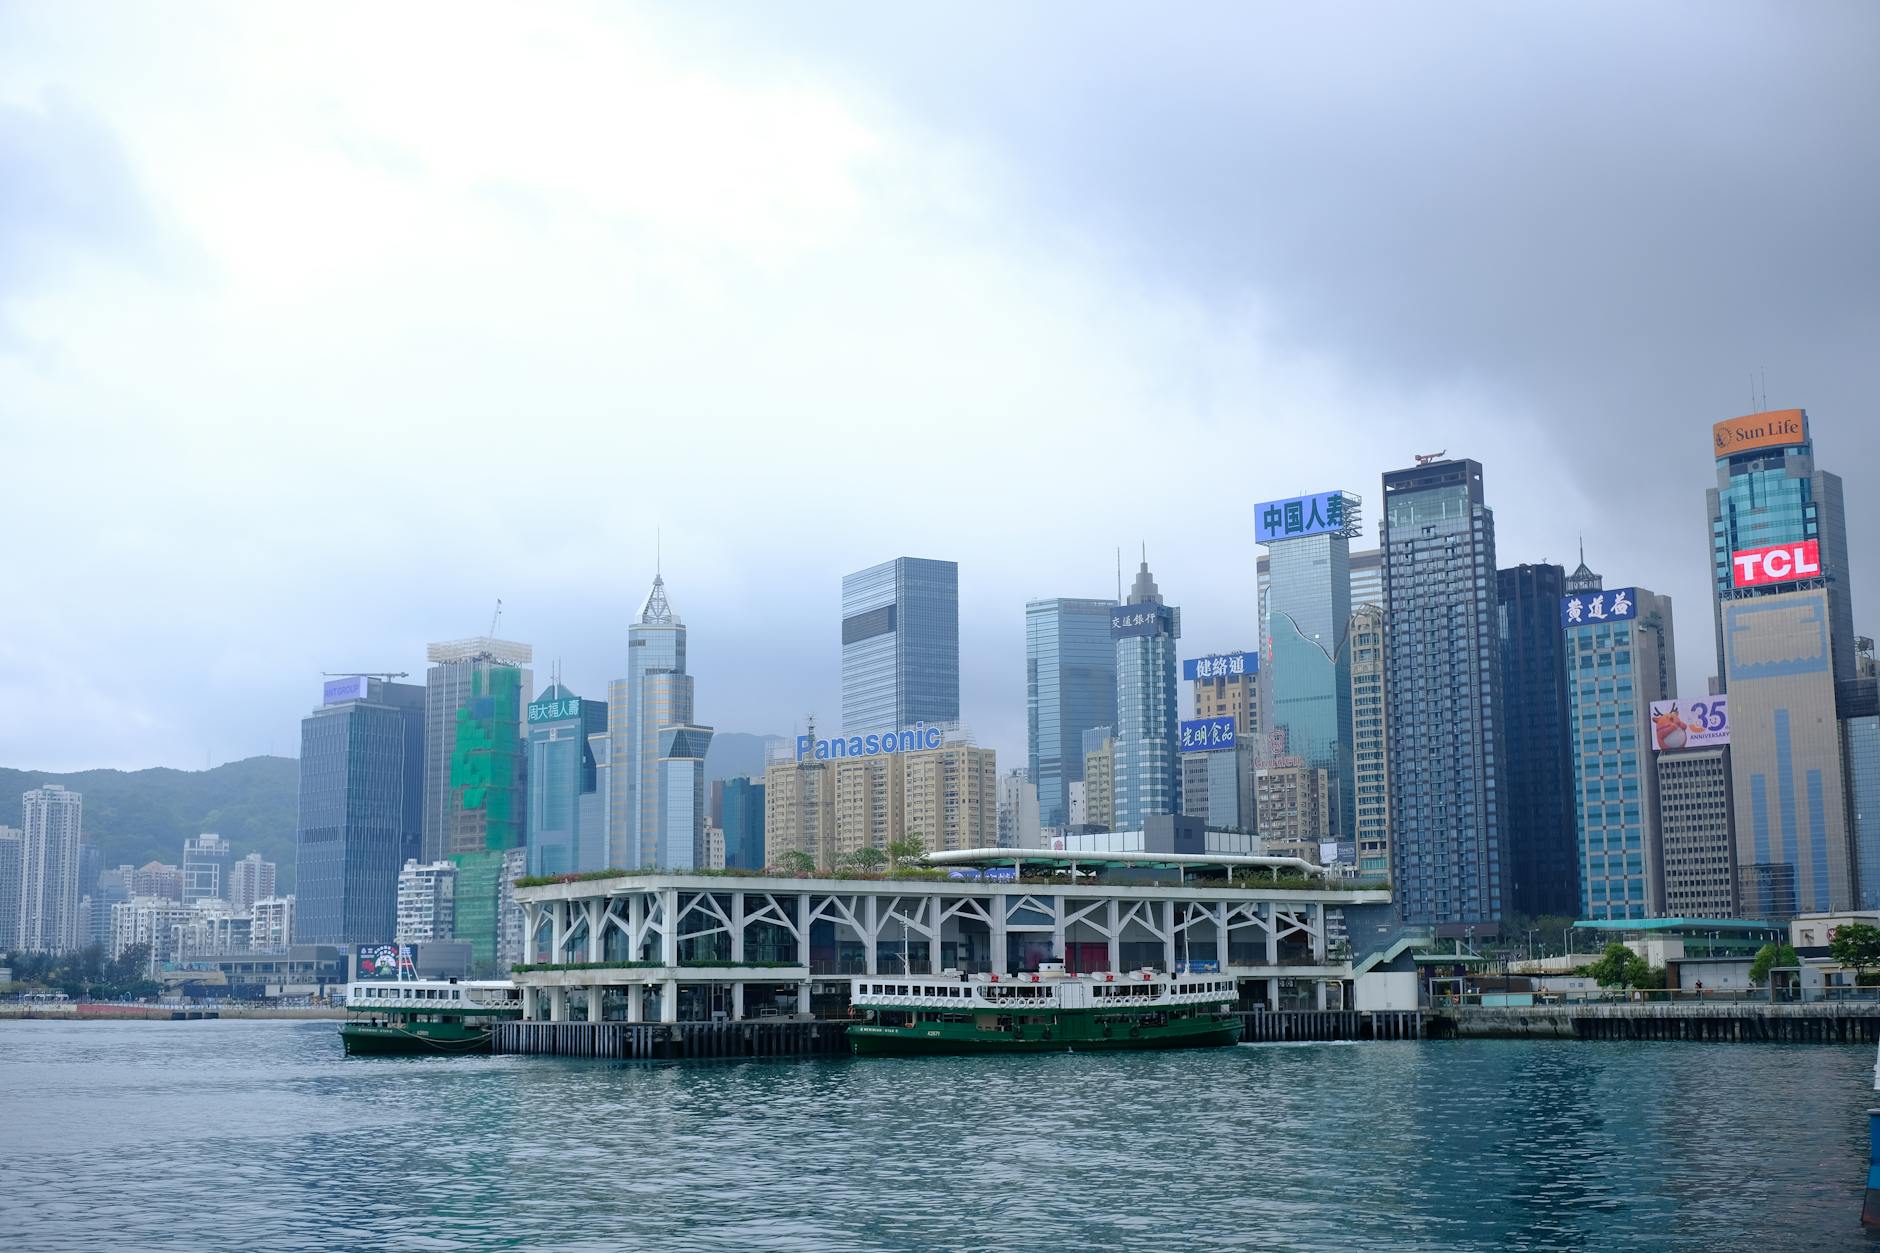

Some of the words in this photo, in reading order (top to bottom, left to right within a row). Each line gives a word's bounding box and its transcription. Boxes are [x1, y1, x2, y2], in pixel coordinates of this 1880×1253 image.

[1735, 427, 1765, 442] Sun
[1768, 419, 1799, 436] Life
[1734, 547, 1818, 581] TCL
[528, 699, 580, 721] 周大福人壽
[1690, 701, 1726, 732] 35
[796, 720, 942, 762] Panasonic
[1182, 721, 1233, 747] 光明食品
[1690, 731, 1730, 740] ANNIVERSARY
